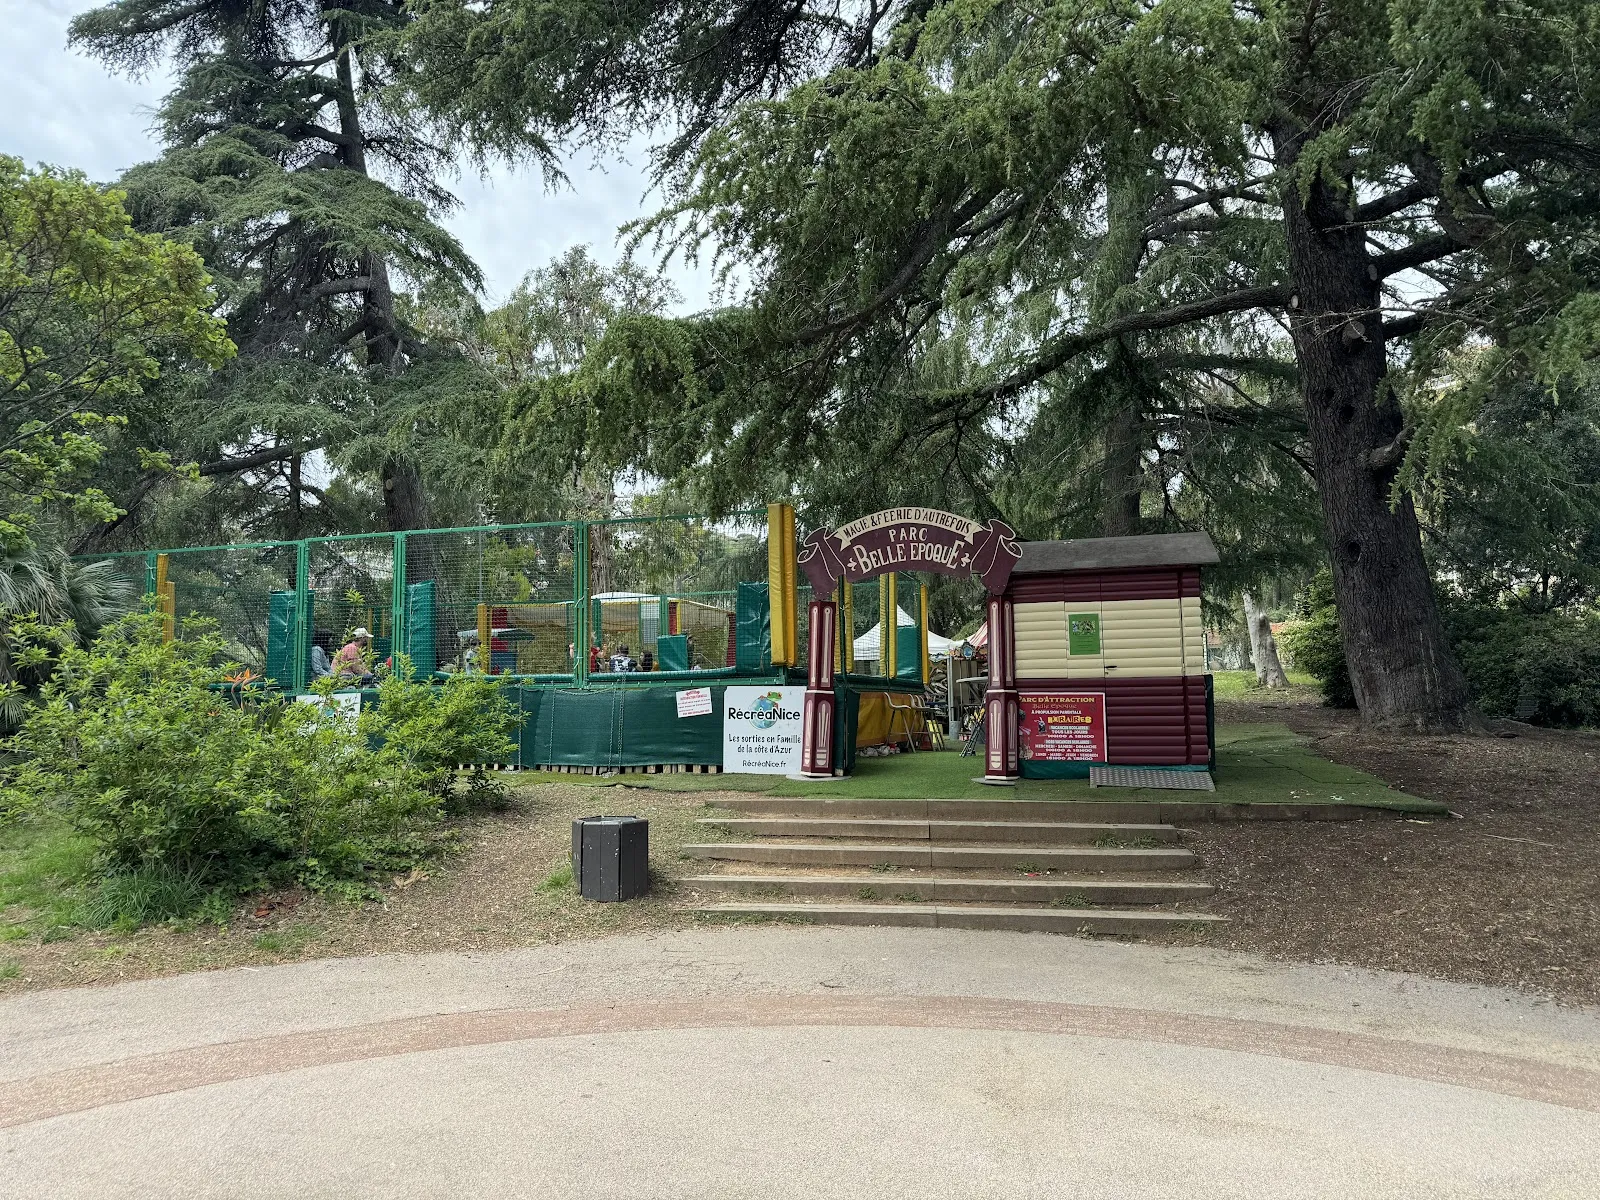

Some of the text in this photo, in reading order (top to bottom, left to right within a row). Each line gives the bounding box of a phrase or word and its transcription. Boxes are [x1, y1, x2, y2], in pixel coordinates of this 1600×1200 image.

[843, 521, 870, 538] MAGIE
[914, 509, 972, 534] D'AUTREFOIS
[888, 527, 928, 542] PARC
[853, 540, 965, 574] BELLE EPOQUE
[728, 707, 800, 720] RécréaNice
[728, 733, 740, 743] Les
[741, 734, 765, 743] sorties
[777, 734, 801, 744] Famille
[737, 744, 745, 753] de
[746, 744, 753, 753] la
[769, 745, 792, 754] d'Azur
